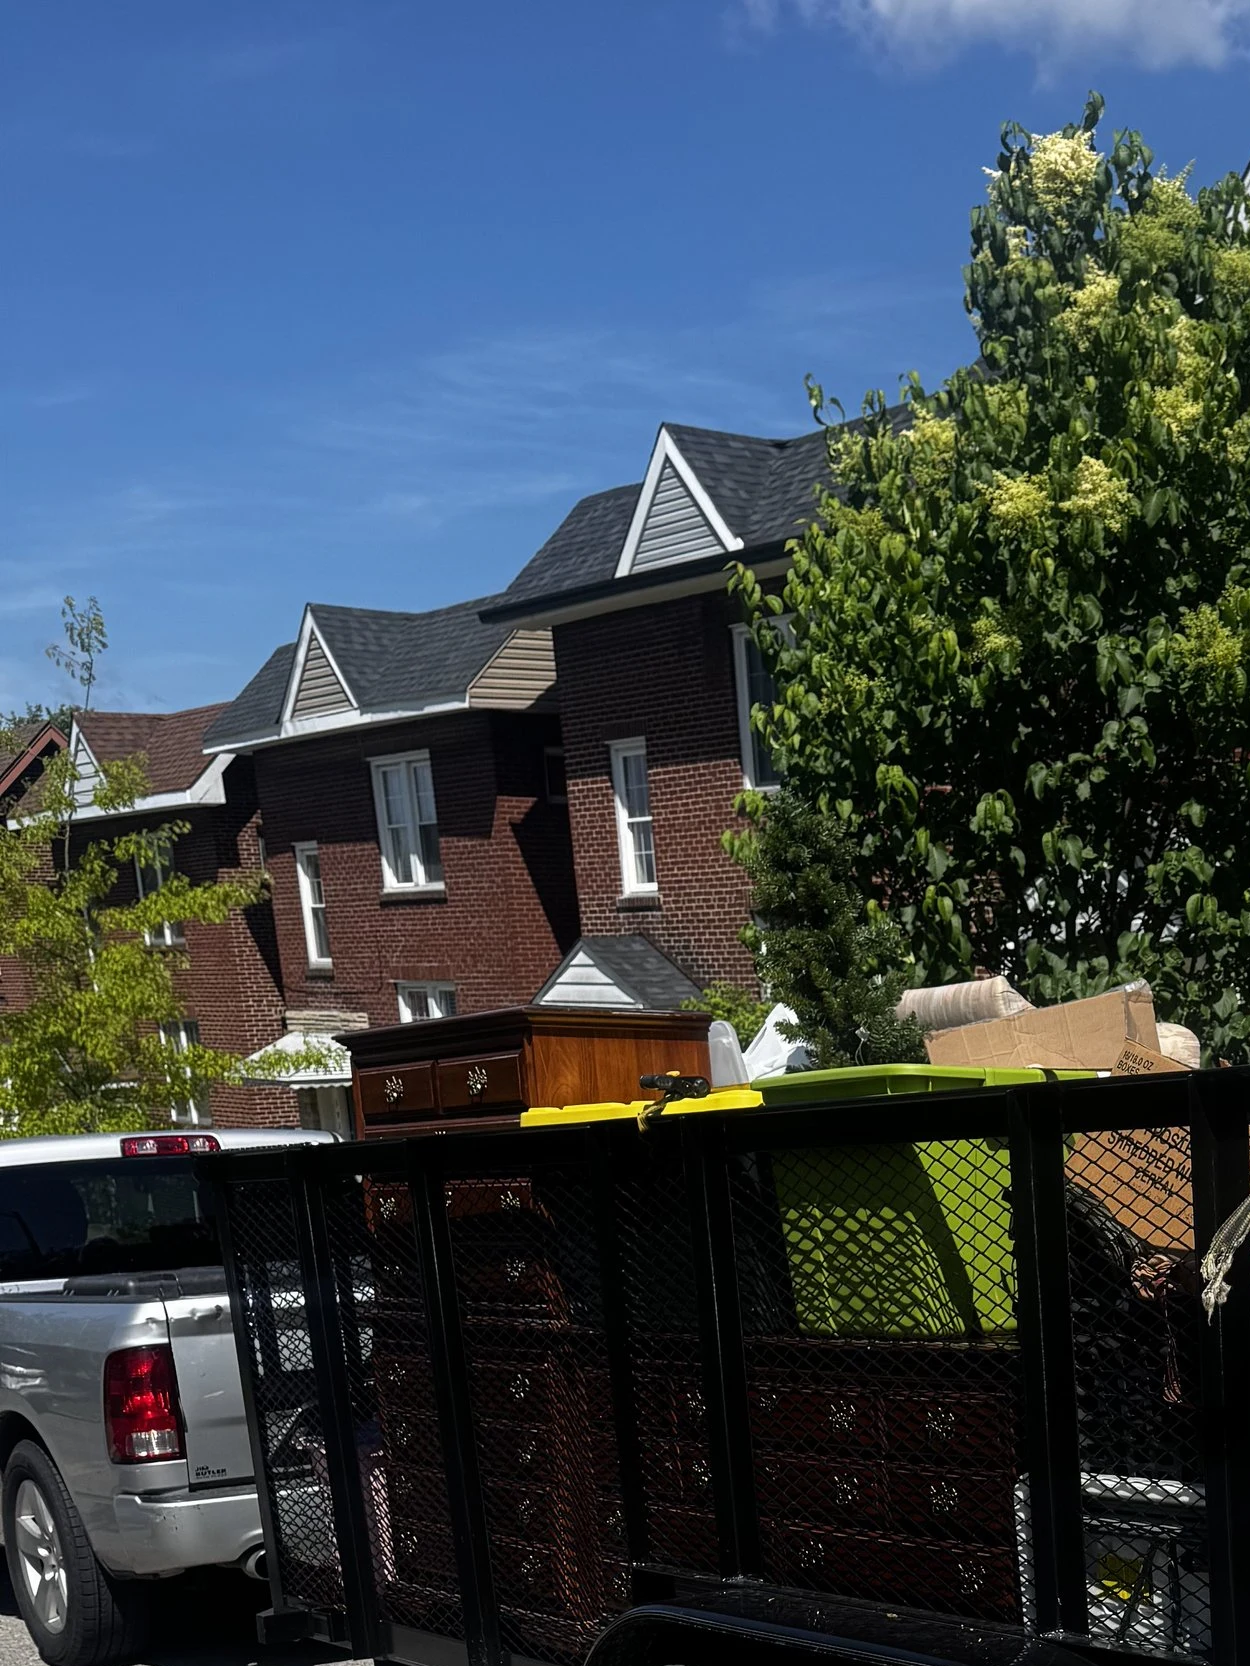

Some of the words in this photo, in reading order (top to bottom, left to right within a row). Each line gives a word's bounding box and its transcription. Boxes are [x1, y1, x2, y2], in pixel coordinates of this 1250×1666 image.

[1116, 1059, 1140, 1076] BOXES
[1142, 1059, 1154, 1071] OZ
[1107, 1131, 1175, 1174] SHREDDED
